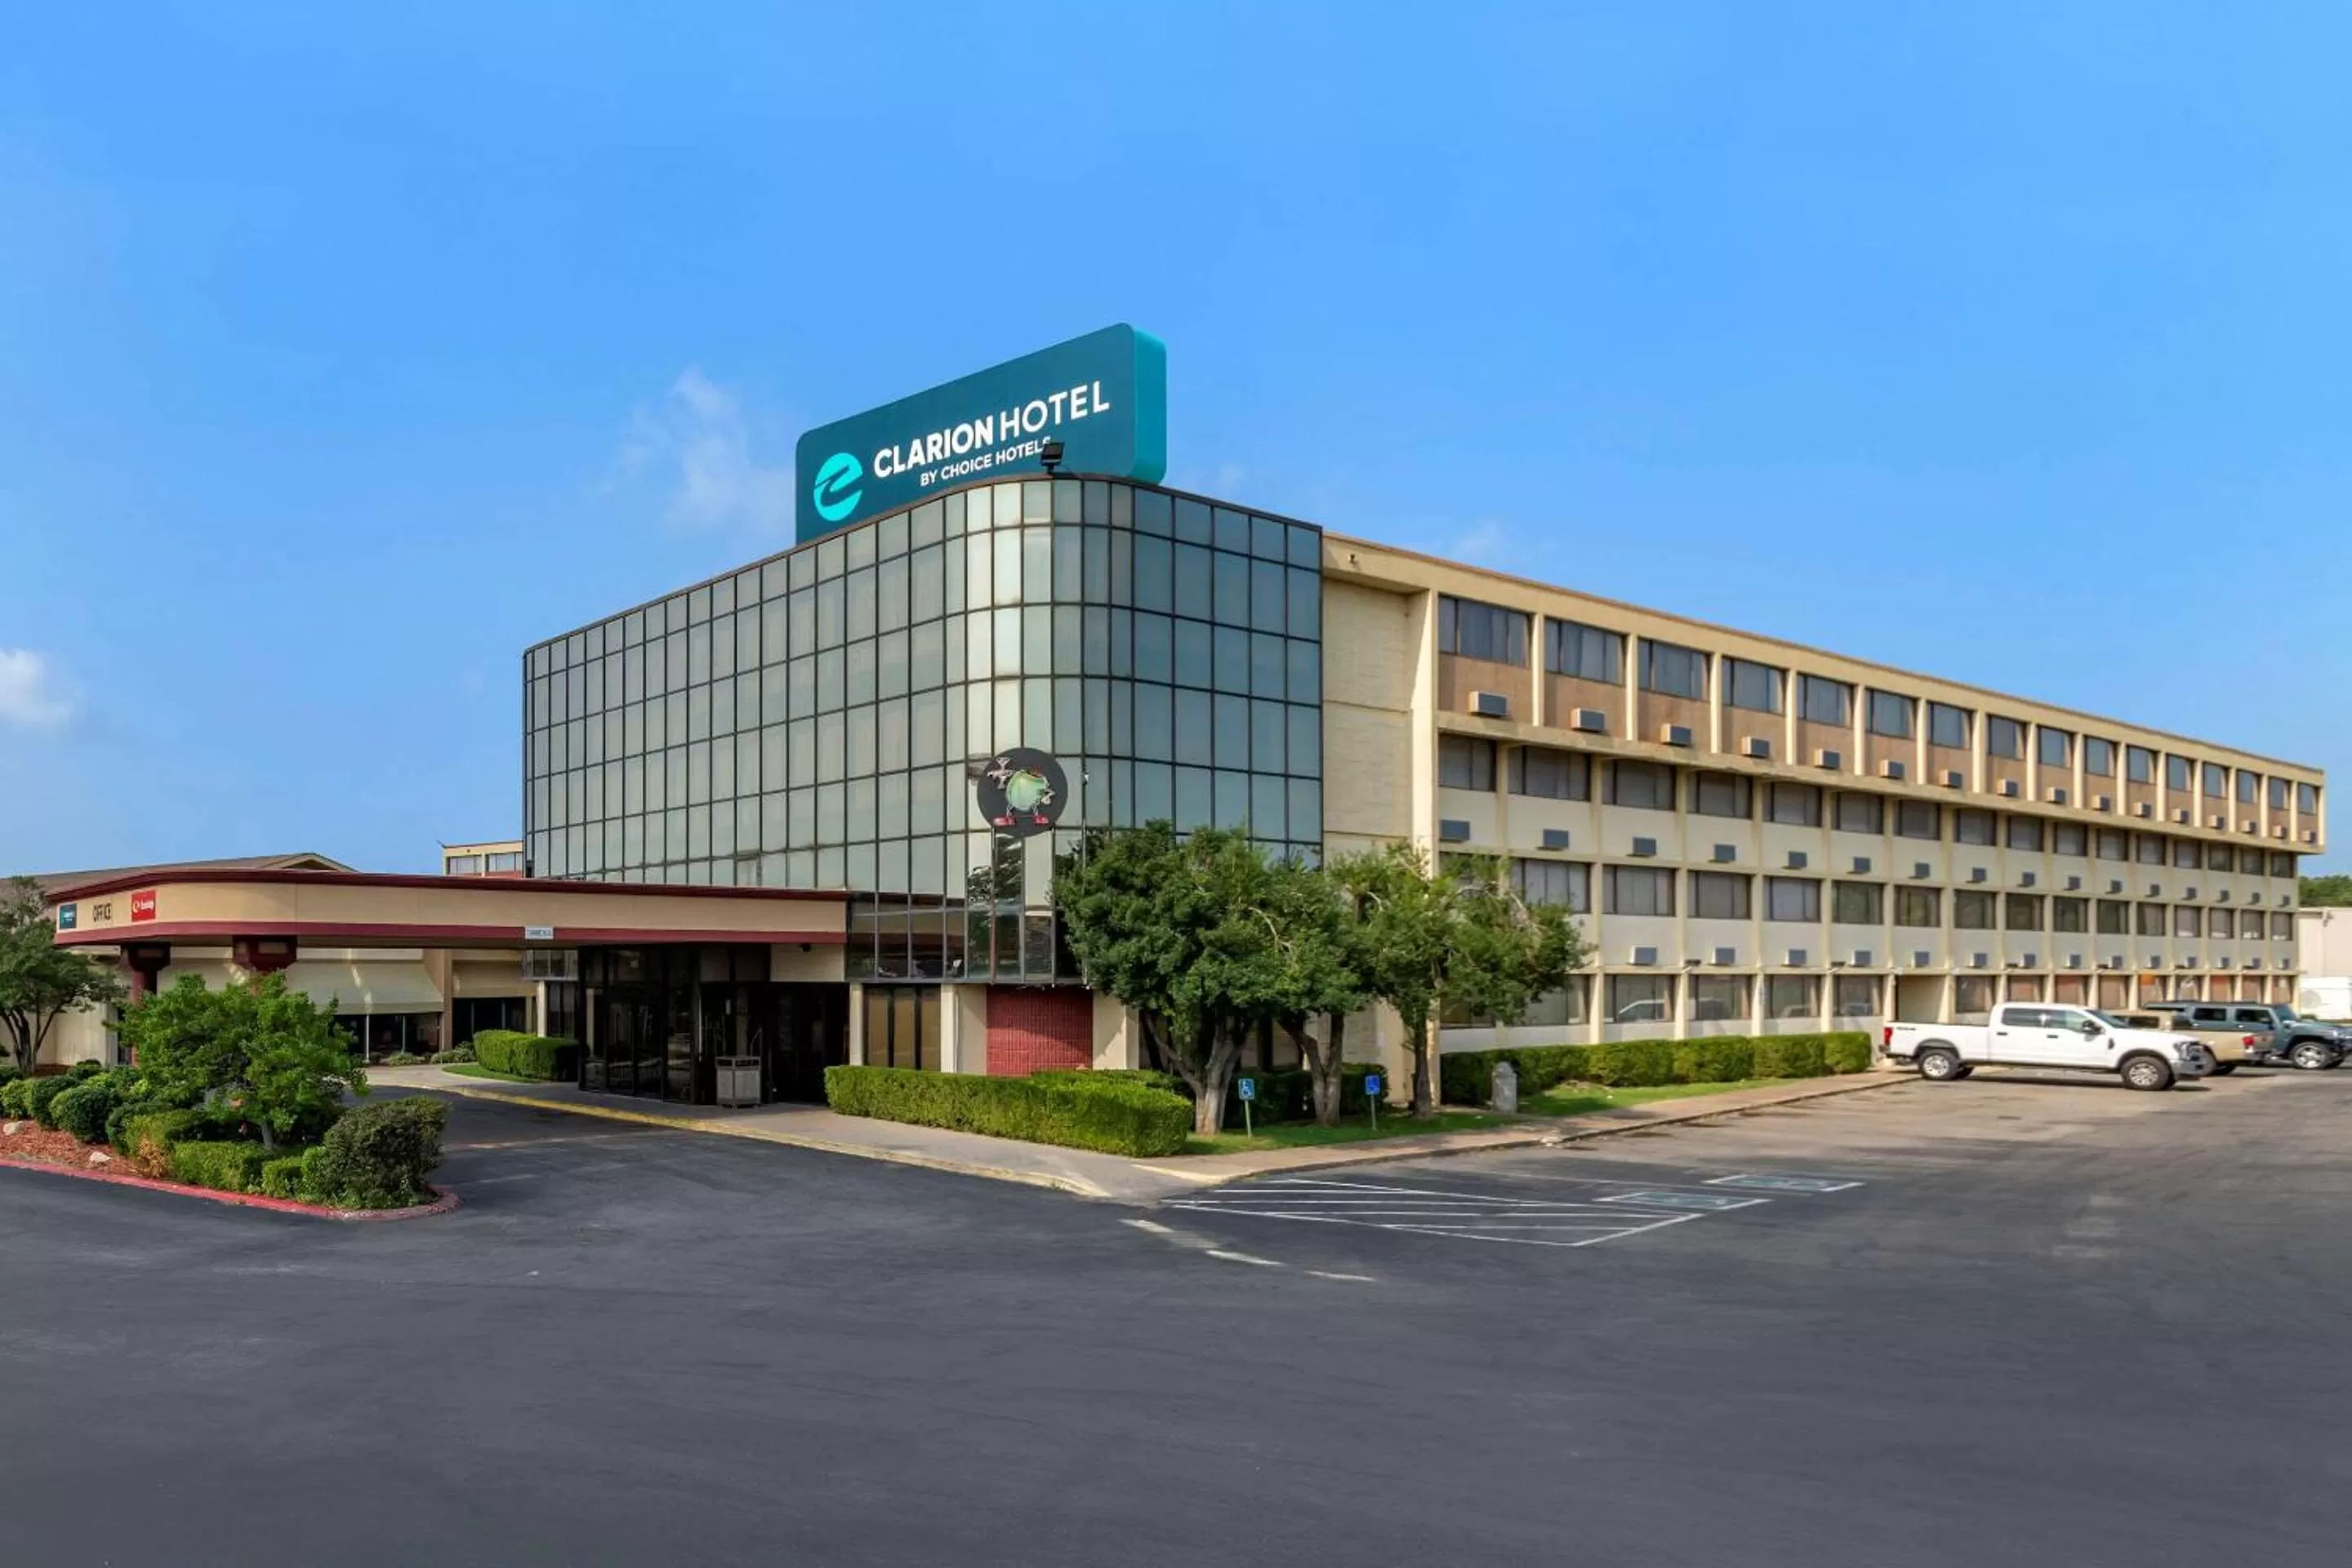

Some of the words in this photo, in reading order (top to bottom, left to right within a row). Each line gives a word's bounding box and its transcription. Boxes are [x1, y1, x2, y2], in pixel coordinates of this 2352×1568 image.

[874, 415, 993, 478] CLARION
[1000, 381, 1110, 439] HOTEL
[920, 470, 937, 488] BY
[941, 452, 992, 480] CHOICE
[92, 902, 112, 922] OFFICE
